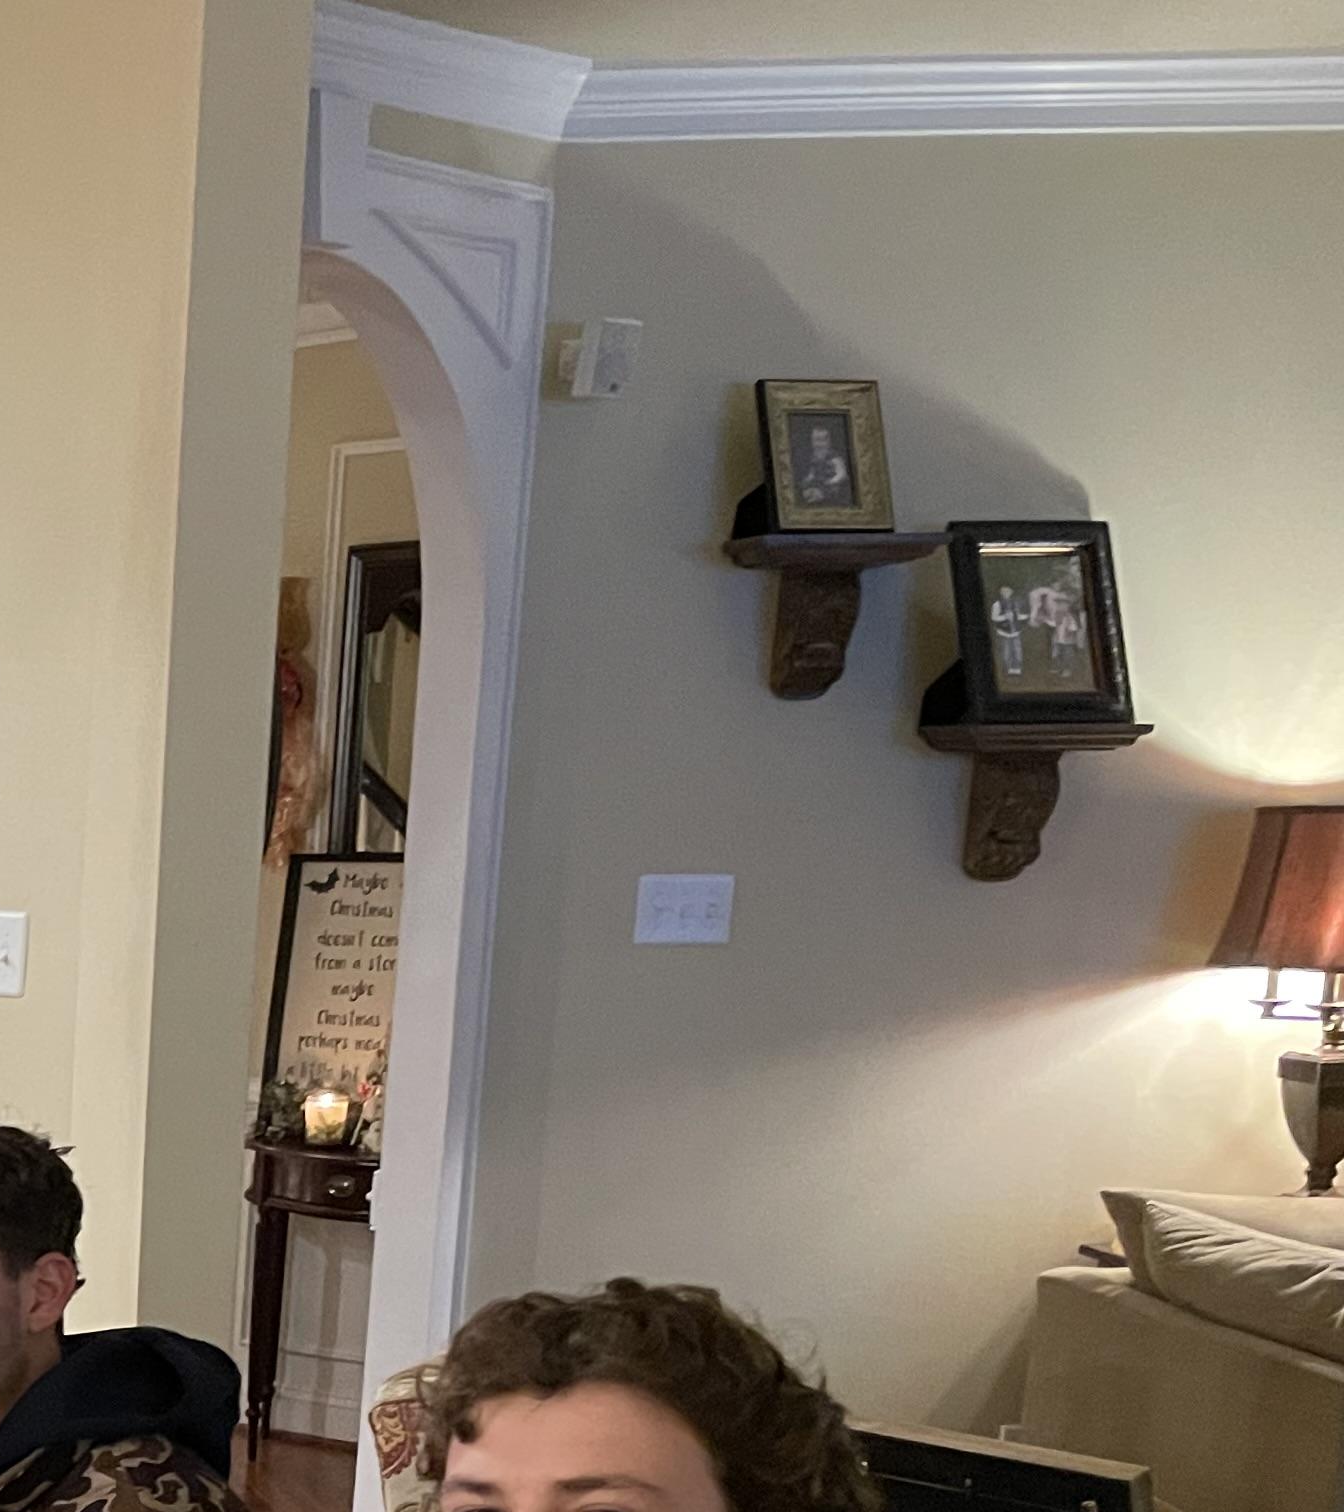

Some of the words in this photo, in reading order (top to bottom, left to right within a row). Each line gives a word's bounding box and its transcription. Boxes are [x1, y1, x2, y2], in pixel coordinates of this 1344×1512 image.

[342, 872, 389, 895] Maybe
[330, 900, 394, 918] Christmas
[371, 935, 399, 947] com
[315, 952, 347, 970] from
[352, 959, 361, 970] a
[368, 954, 397, 972] stor
[331, 979, 375, 1002] maybe
[317, 1009, 381, 1027] Christmas
[298, 1031, 348, 1054] perhaps
